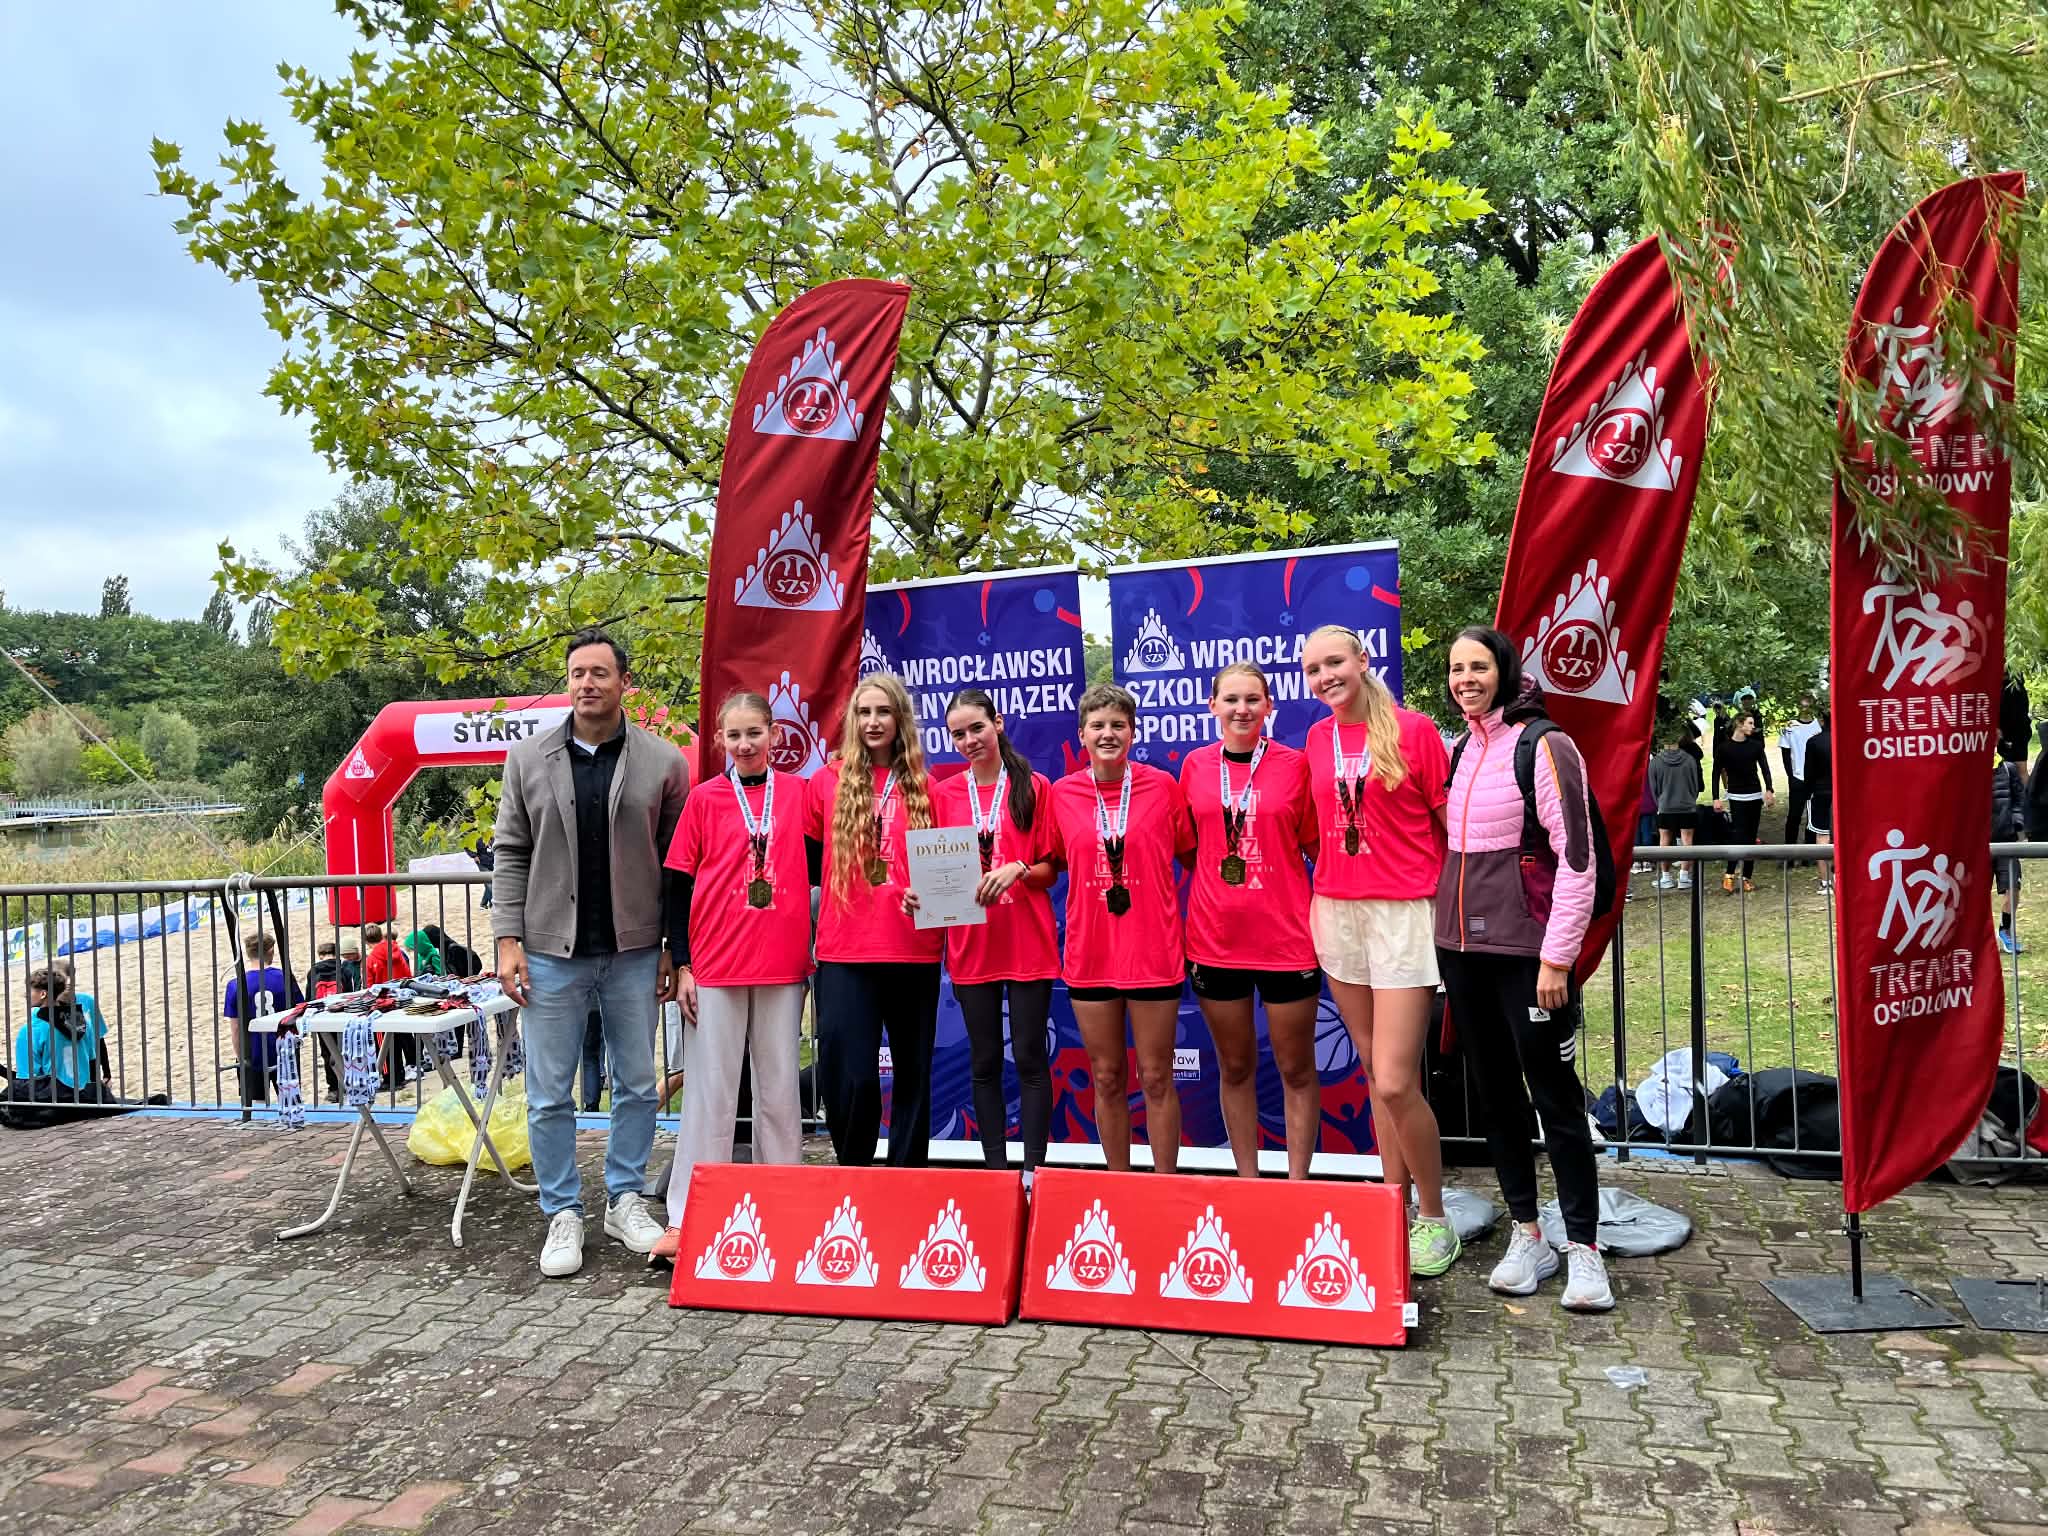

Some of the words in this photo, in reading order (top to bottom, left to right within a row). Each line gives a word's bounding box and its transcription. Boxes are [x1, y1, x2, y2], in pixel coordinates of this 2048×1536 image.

[793, 406, 829, 422] SZS
[1600, 443, 1640, 463] SZS
[775, 579, 810, 594] SZS
[1191, 628, 1387, 669] WROCŁAKI
[1145, 653, 1165, 663] SZS
[902, 648, 1073, 687] WROCŁAWSKI
[1553, 657, 1594, 677] SZS
[1125, 676, 1216, 708] SZKOL
[1859, 693, 1990, 732] TRENER
[454, 719, 539, 743] START
[1864, 731, 1988, 759] OSIEDLOWY
[916, 842, 970, 856] DYPLOM
[1874, 985, 1973, 1025] OSIEDLOWY
[724, 1255, 749, 1268] SZS
[825, 1259, 851, 1272] SZS
[931, 1263, 957, 1277] SZS
[1077, 1265, 1106, 1279] SZS
[1191, 1273, 1222, 1287] SZS
[1311, 1280, 1343, 1295] SZS
